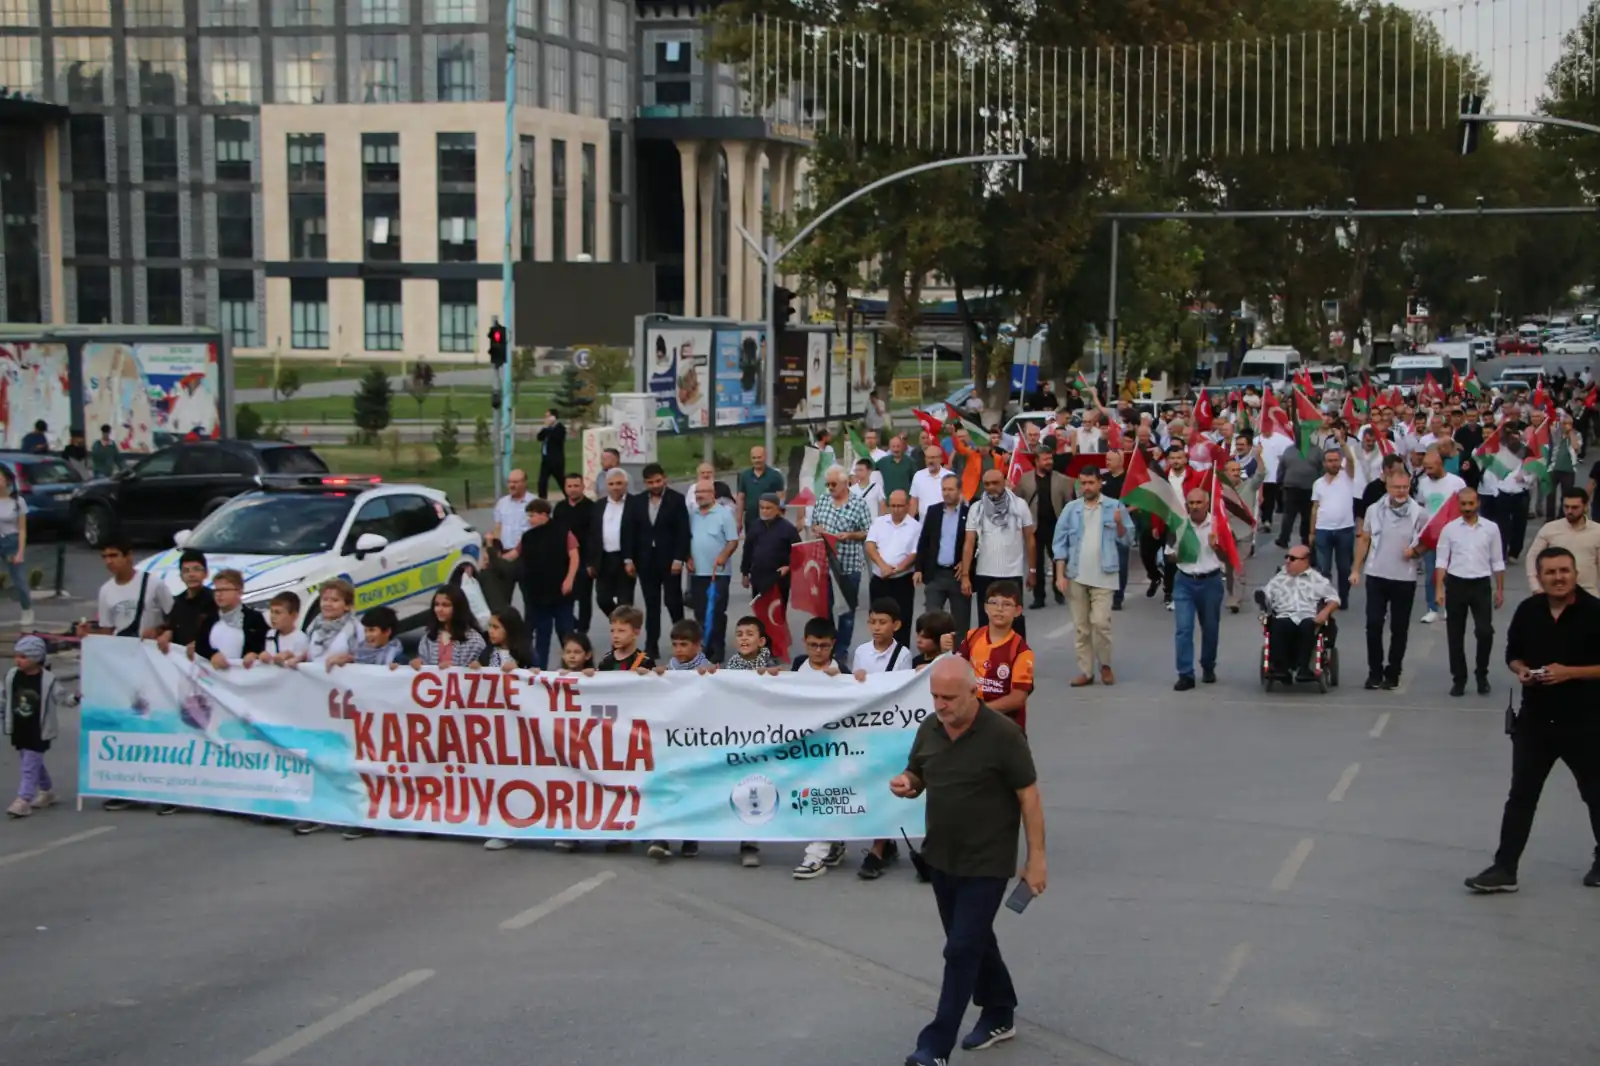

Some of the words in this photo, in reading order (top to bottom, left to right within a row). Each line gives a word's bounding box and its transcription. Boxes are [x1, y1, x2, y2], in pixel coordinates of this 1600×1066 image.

[665, 723, 815, 749] Kütahya'dan
[98, 735, 195, 766] Sumud
[358, 764, 642, 832] YÜRÜYORUZ!
[810, 785, 857, 797] GLOBAL
[811, 796, 850, 807] SUMUD
[811, 805, 867, 816] FLOTILLA
